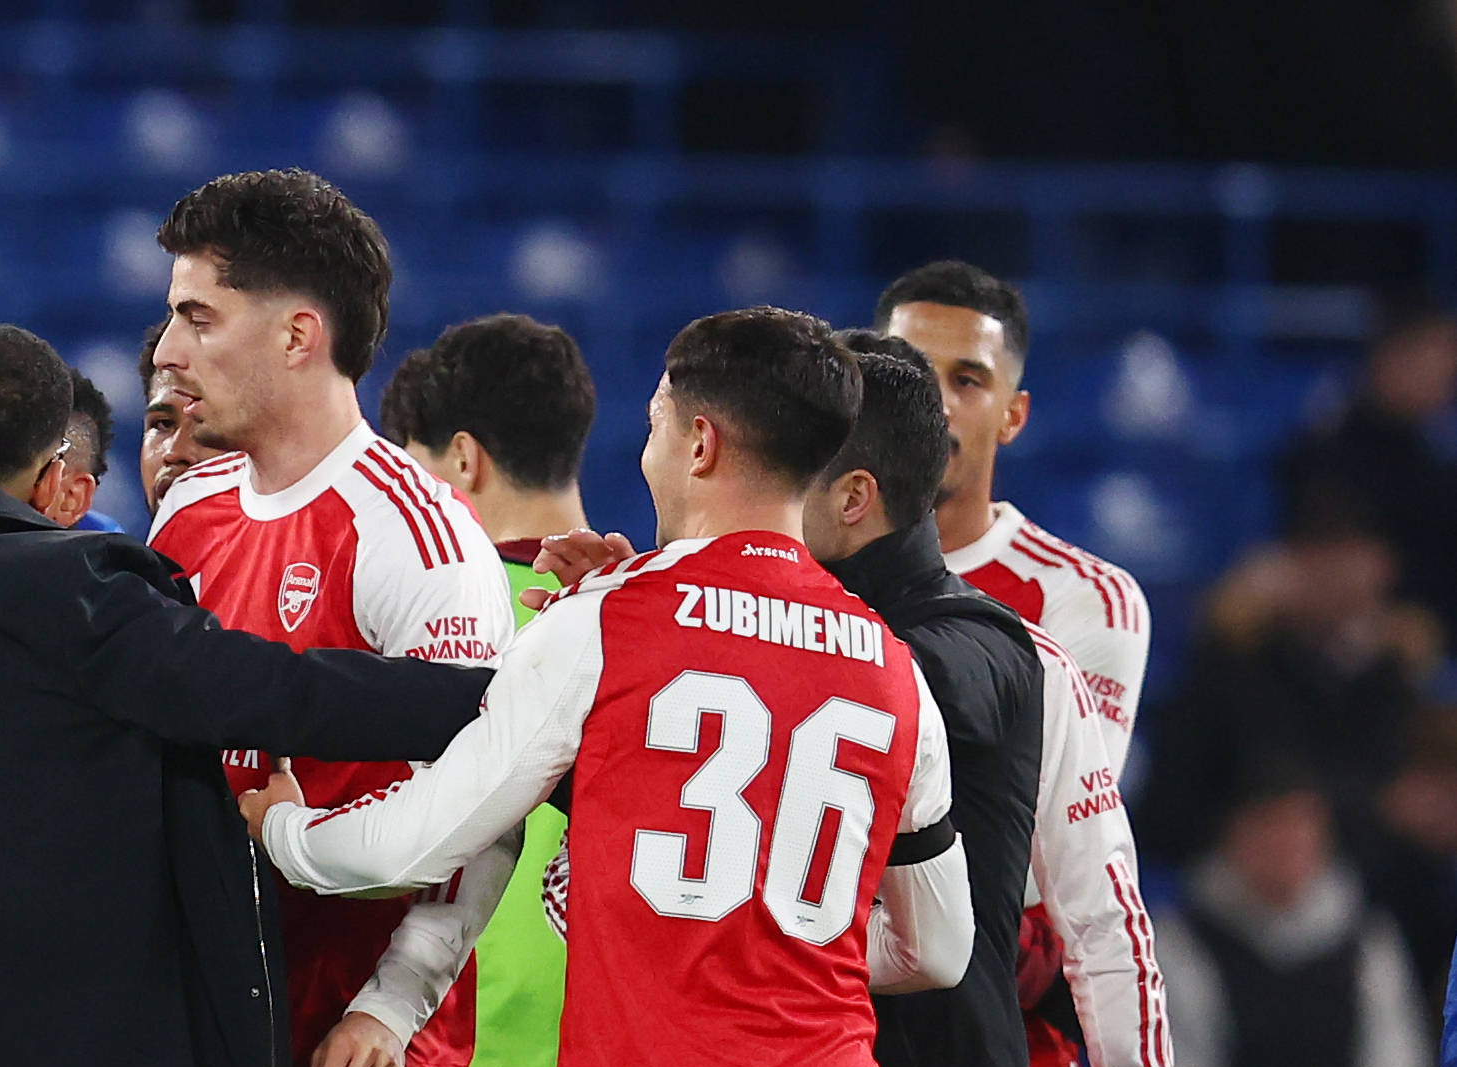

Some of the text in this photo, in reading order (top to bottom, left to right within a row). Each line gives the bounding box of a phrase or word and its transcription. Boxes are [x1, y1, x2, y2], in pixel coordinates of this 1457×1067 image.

[424, 616, 478, 639] VISIT
[674, 583, 884, 668] ZUBIMENDI
[1080, 767, 1114, 793] VIS
[629, 669, 897, 947] 36
[1067, 790, 1123, 825] RWAN
